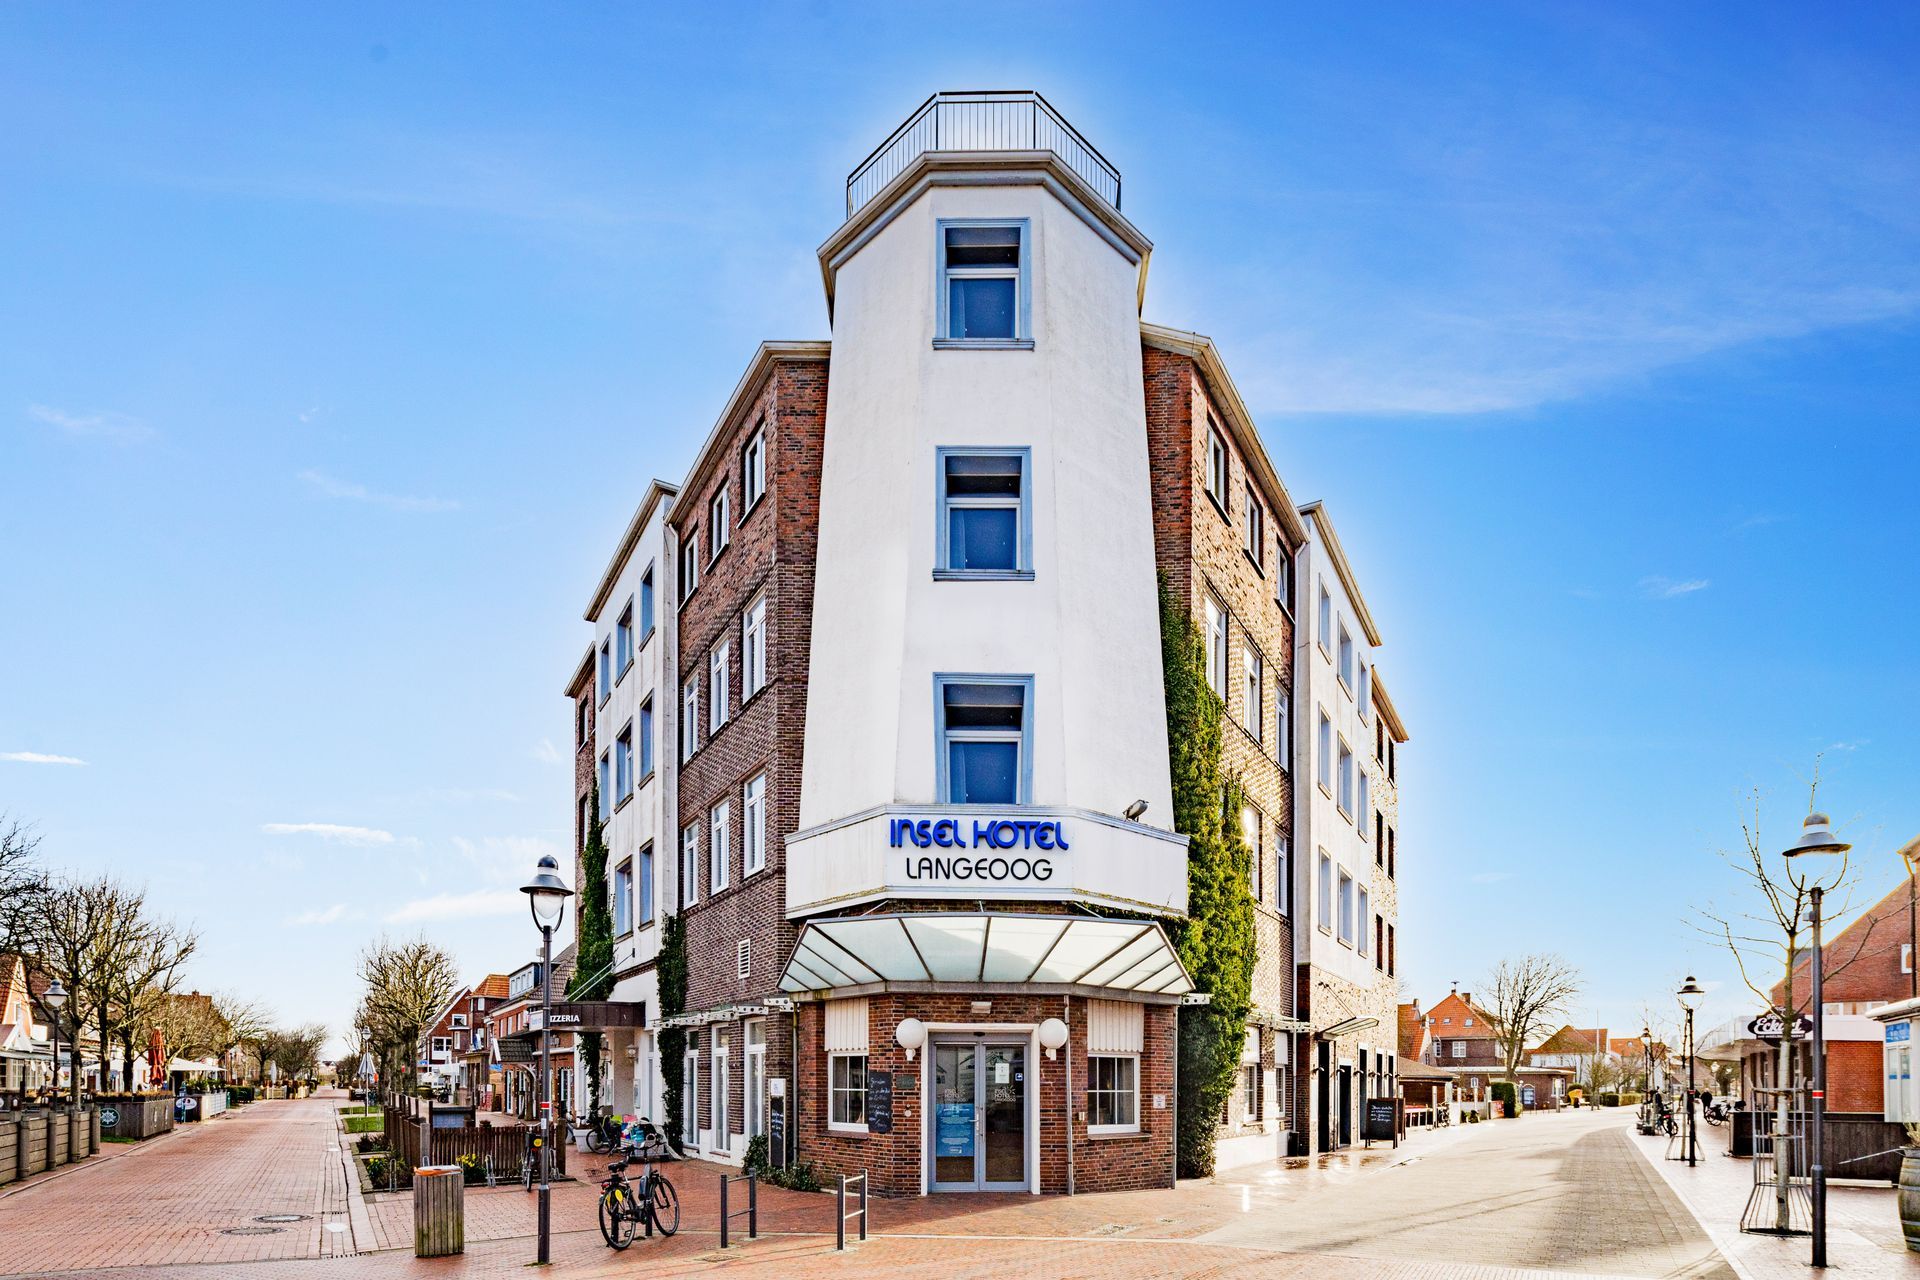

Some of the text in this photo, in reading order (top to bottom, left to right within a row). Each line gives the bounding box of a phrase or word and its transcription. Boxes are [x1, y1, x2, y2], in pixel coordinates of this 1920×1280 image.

[890, 819, 1069, 850] INSEL HOTEL
[906, 857, 1053, 881] LANGEOOG
